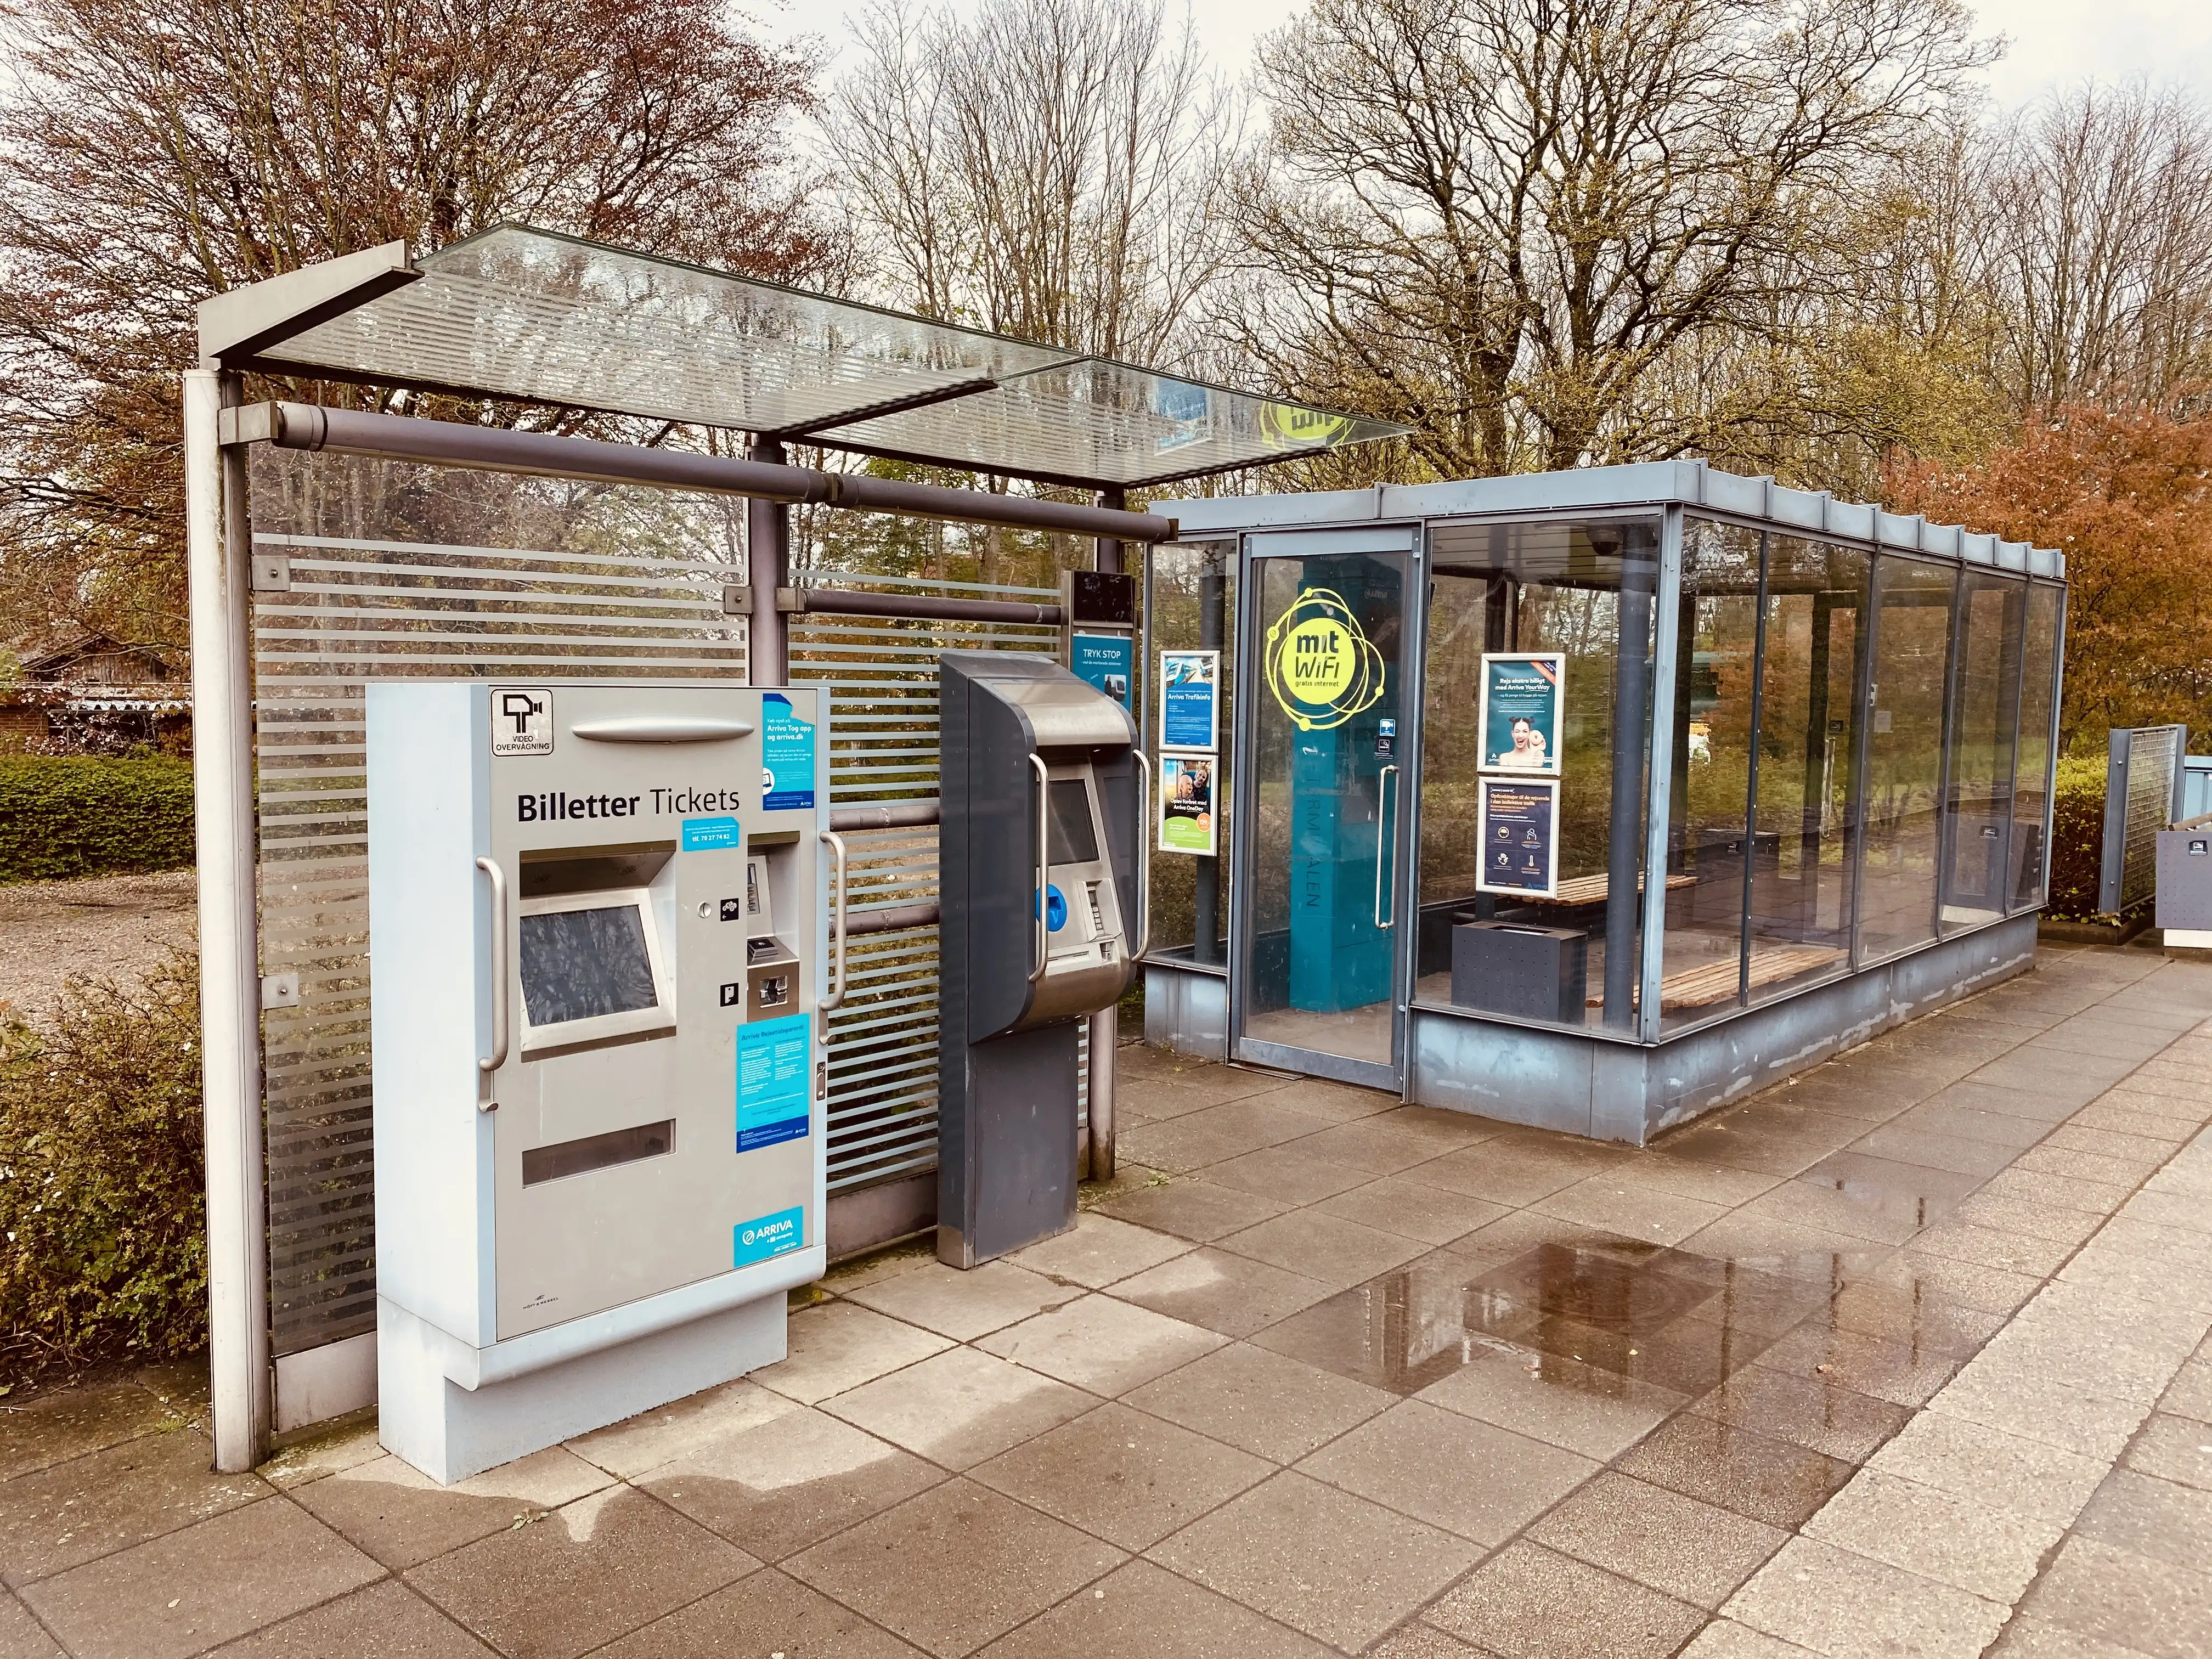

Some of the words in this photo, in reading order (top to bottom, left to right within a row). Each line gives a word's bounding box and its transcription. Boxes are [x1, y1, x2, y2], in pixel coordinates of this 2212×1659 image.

[1296, 630, 1339, 653] mit
[1083, 649, 1102, 658] TRYK
[1102, 650, 1121, 659] STOP
[1295, 656, 1340, 679] WiFi
[787, 725, 799, 733] Tog
[496, 742, 550, 751] OVERVÅGNING
[518, 792, 641, 822] Billetter
[649, 786, 741, 815] Tickets
[741, 1033, 760, 1041] Arriva
[760, 1024, 804, 1037] Rejsetidsgaranti
[755, 1219, 793, 1240] ARRIVA
